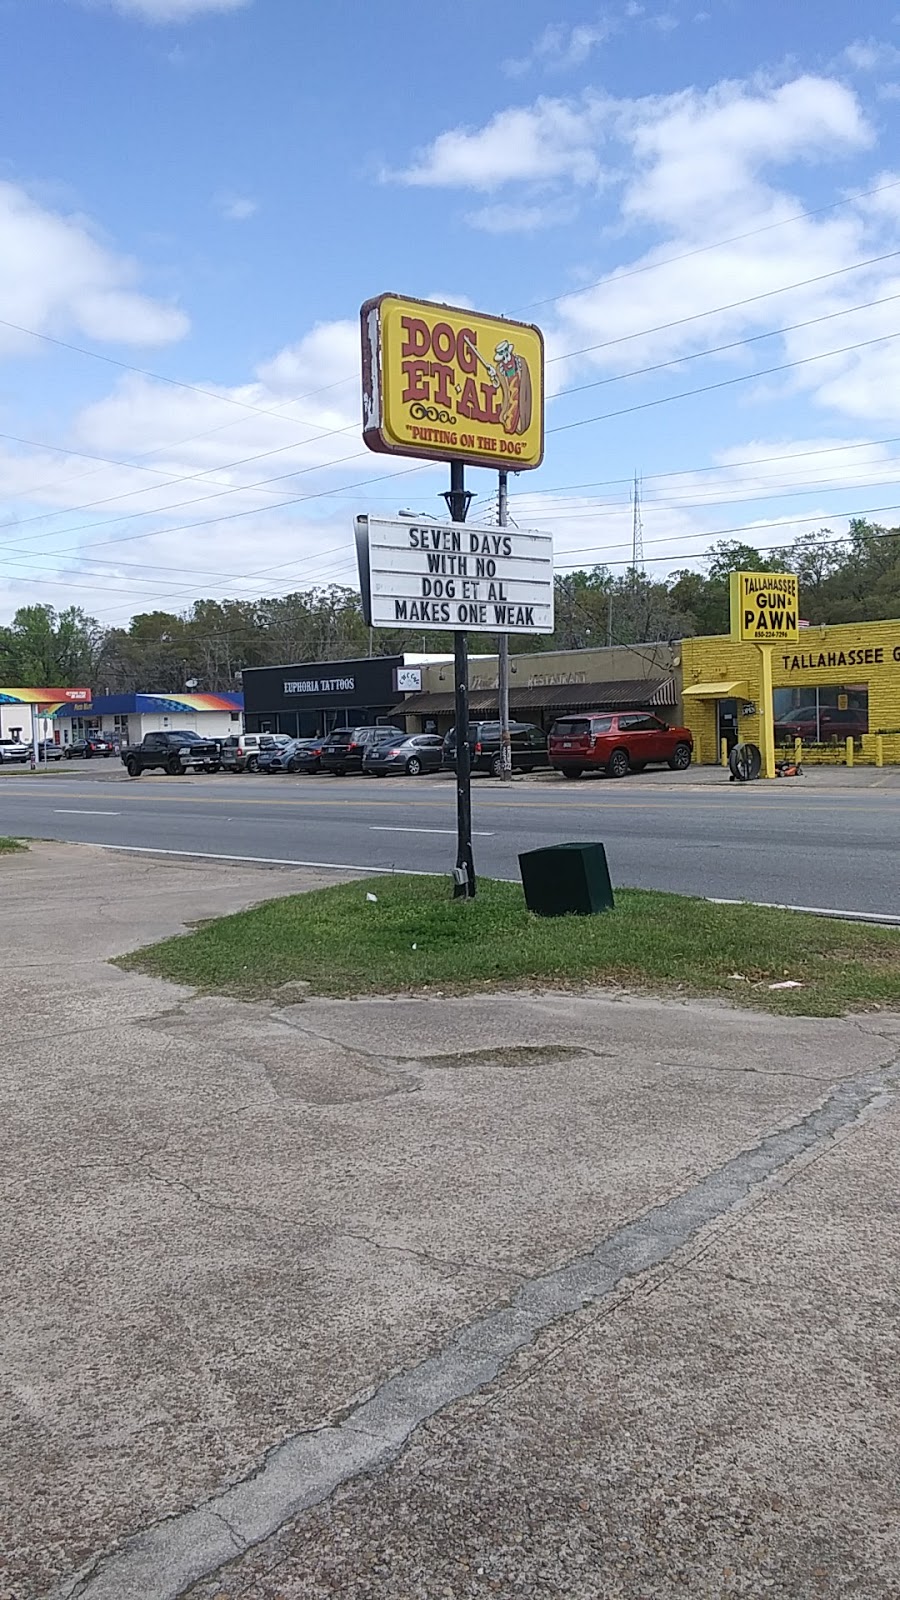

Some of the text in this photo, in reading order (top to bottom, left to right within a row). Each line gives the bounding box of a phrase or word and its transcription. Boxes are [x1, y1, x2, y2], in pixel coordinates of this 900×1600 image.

[401, 316, 477, 376] DOG
[460, 434, 475, 448] ON
[477, 436, 497, 451] THE
[409, 527, 512, 556] SEVEN DAYS
[426, 553, 496, 577] WITH NO
[422, 577, 507, 601] DOG ET AL
[744, 577, 796, 598] TALLAHASSEE
[756, 593, 786, 609] GUN
[394, 600, 535, 626] MAKES ONE WEAK
[744, 610, 796, 630] PAWN
[782, 647, 884, 670] TALLAHASSEE
[283, 678, 355, 694] EUPHORIA TATTOOS
